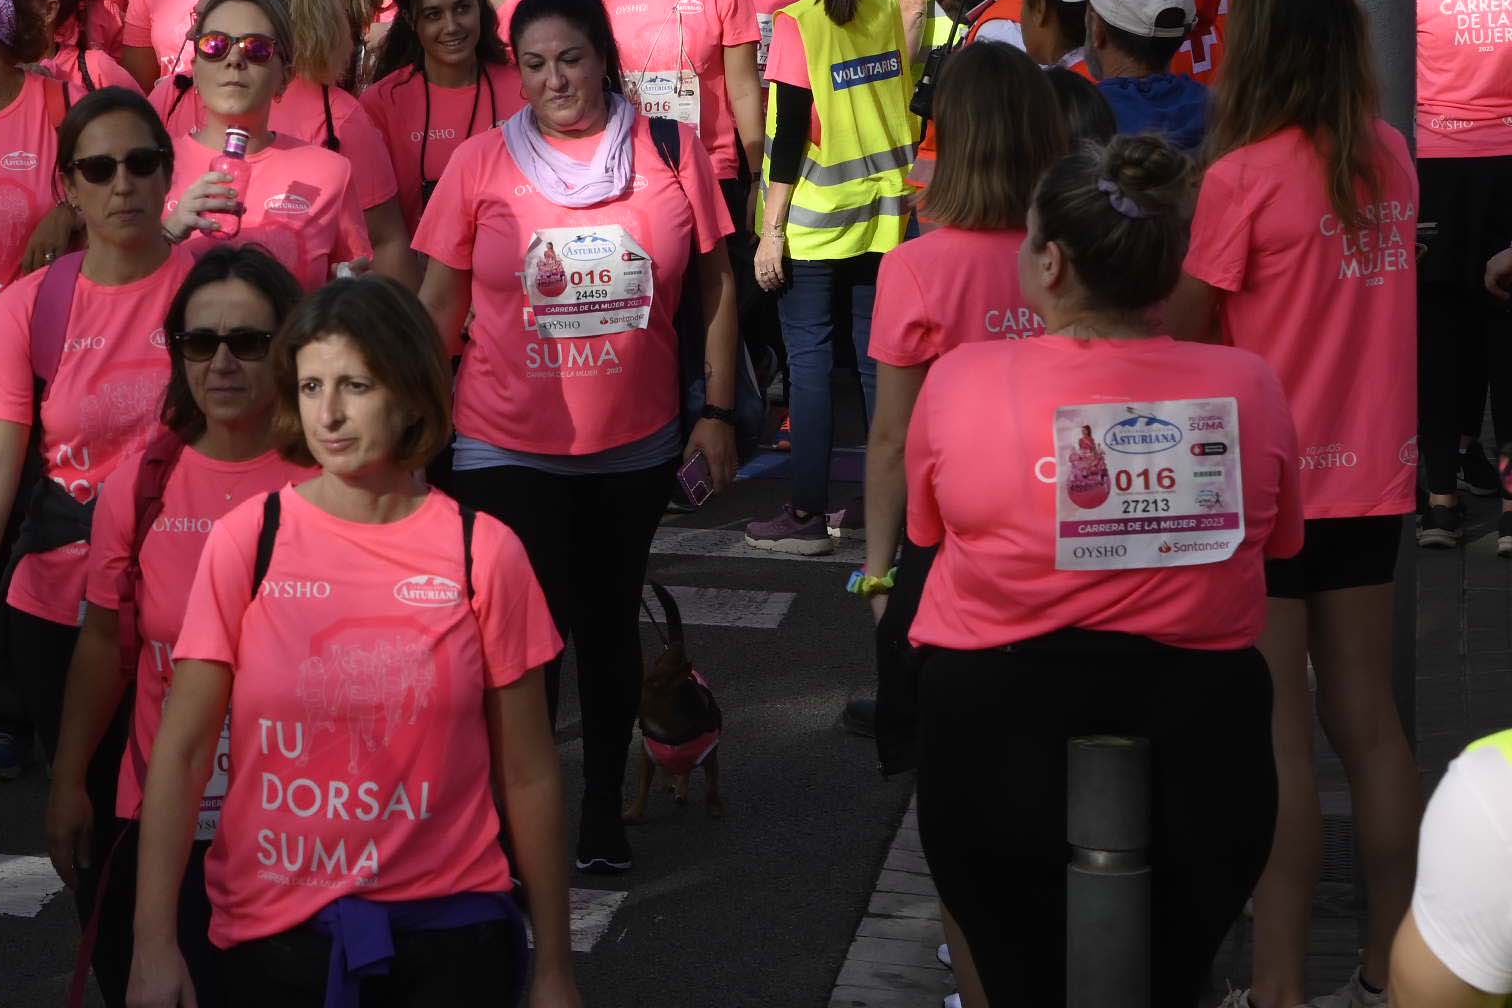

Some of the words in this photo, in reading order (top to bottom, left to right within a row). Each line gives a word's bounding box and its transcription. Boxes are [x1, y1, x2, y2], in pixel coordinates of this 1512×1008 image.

[1457, 13, 1481, 29] DE
[1488, 12, 1510, 27] LA
[645, 101, 671, 113] 016
[1338, 249, 1409, 280] MUJER
[570, 269, 613, 286] 016
[575, 289, 608, 301] 24459
[546, 306, 578, 314] CARRERA
[544, 320, 580, 330] OYSHO
[64, 336, 106, 353] YSHO
[526, 341, 619, 369] SUMA
[1189, 422, 1225, 432] SUMA
[1110, 431, 1176, 447] ASTURIANA
[1115, 468, 1176, 492] 016
[1122, 499, 1170, 514] 27213
[1078, 523, 1125, 533] CARRERA
[1128, 522, 1141, 531] DE
[1144, 521, 1157, 530] LA
[1161, 519, 1197, 529] MUJER
[1073, 544, 1127, 559] OYSHO
[1173, 541, 1230, 553] Santander
[258, 718, 304, 760] TU
[261, 771, 432, 822] DORSAL
[257, 829, 381, 875] SUMA
